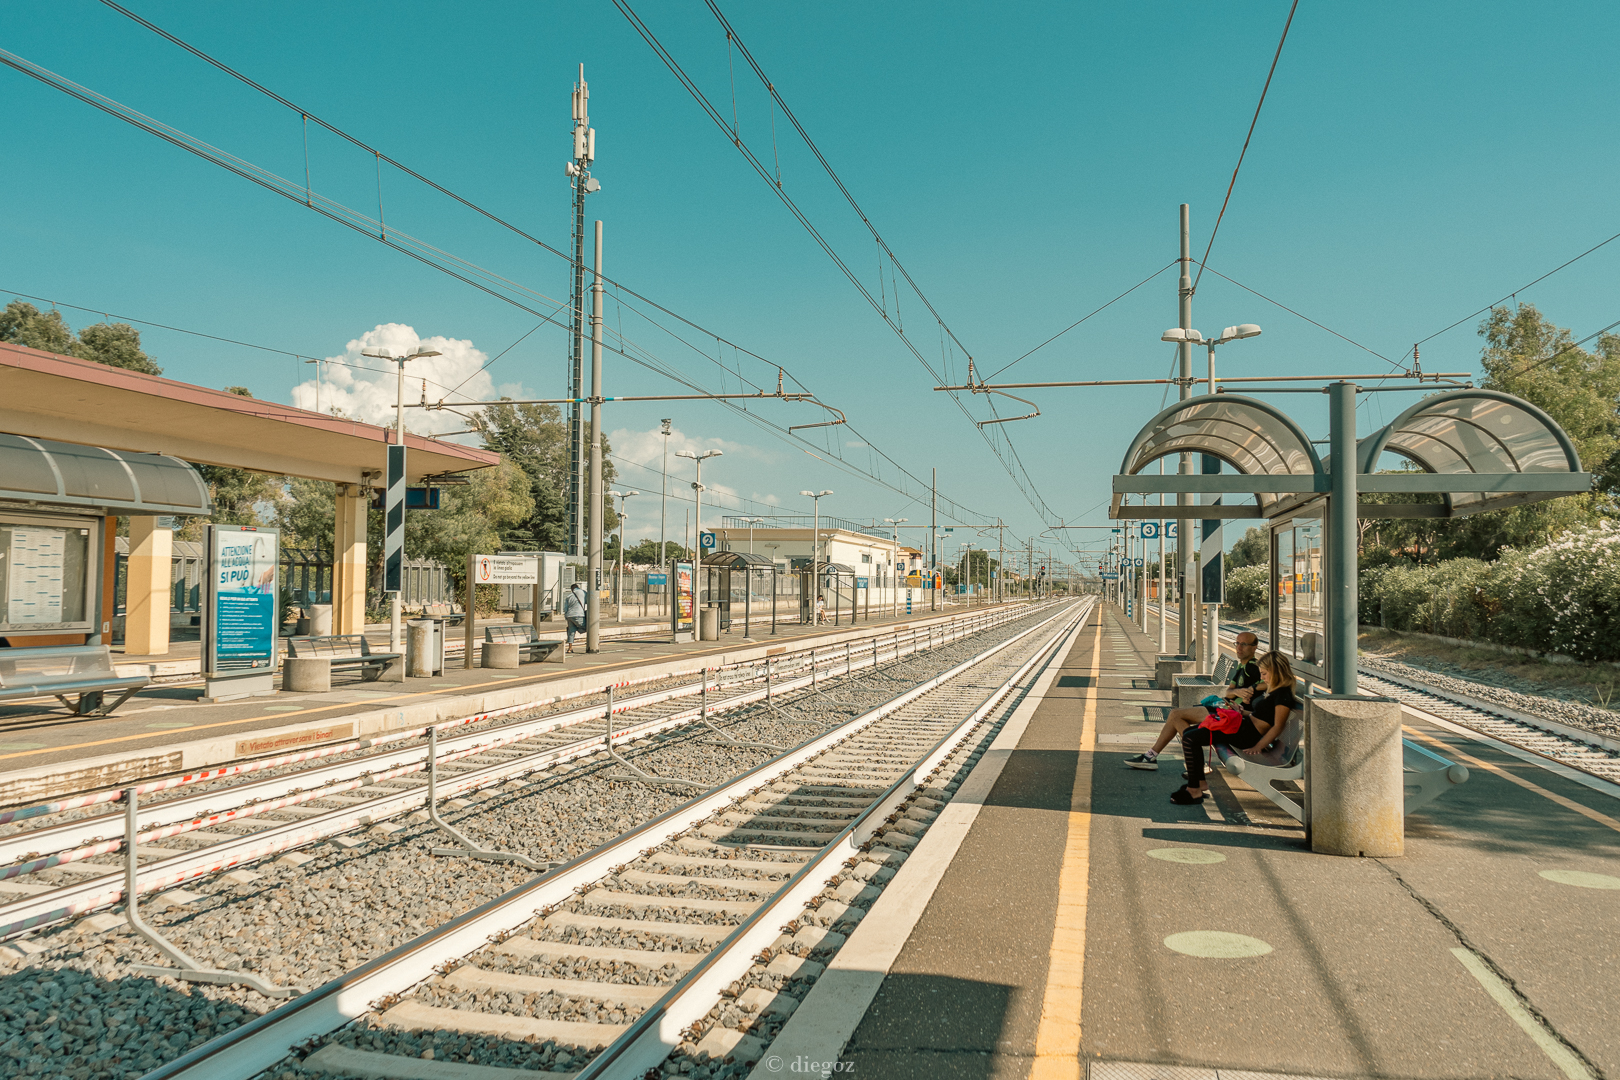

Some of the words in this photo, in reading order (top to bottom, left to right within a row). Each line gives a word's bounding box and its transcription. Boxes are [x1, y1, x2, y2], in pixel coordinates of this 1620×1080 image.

[1146, 526, 1152, 534] 3
[705, 537, 711, 545] 2
[221, 545, 252, 557] ATTENZIONE
[220, 572, 228, 583] SI
[231, 566, 249, 582] PUÒ
[249, 741, 274, 751] Vietato
[274, 736, 312, 747] attraversare
[316, 730, 334, 740] binari
